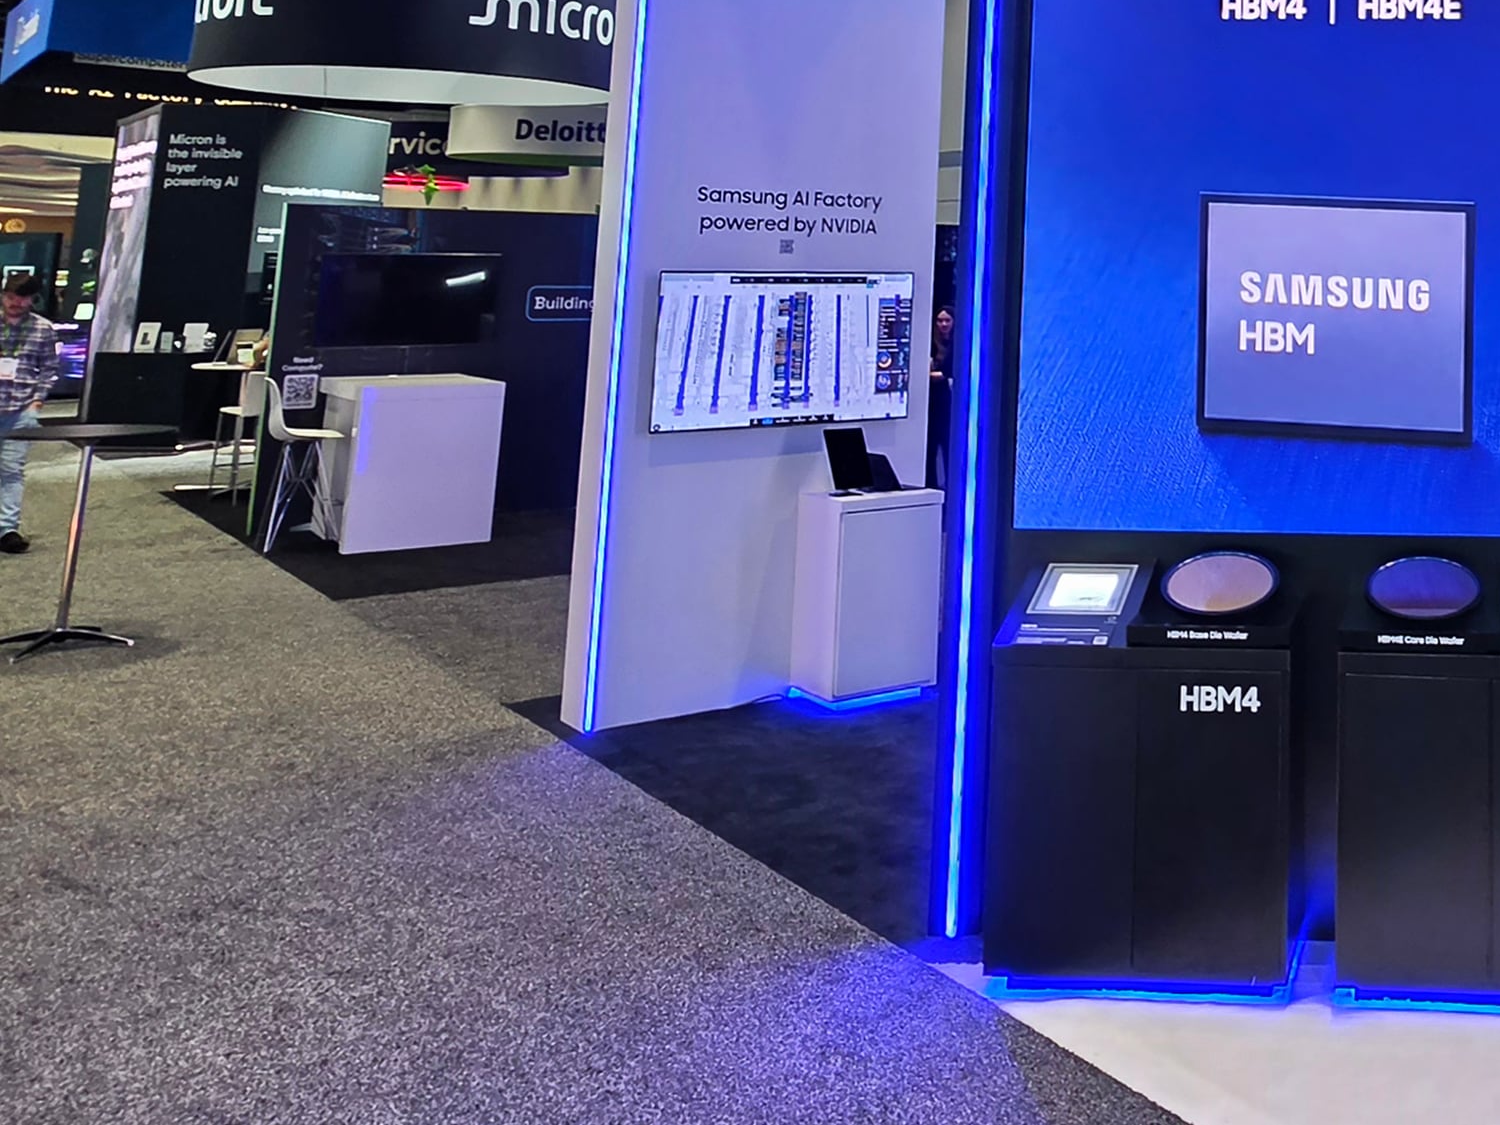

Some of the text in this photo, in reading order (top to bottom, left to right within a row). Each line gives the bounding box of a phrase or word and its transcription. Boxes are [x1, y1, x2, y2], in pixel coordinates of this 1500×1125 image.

[169, 133, 227, 145] Micron is
[167, 147, 243, 159] the invisible
[165, 162, 198, 175] layer
[163, 175, 239, 190] powering AI
[698, 186, 882, 214] Samsung AI Factory
[699, 216, 877, 237] powered by NVIDIA
[1240, 270, 1430, 312] SAMSUNG
[1238, 319, 1316, 355] HBM
[1179, 684, 1261, 714] HBM4
